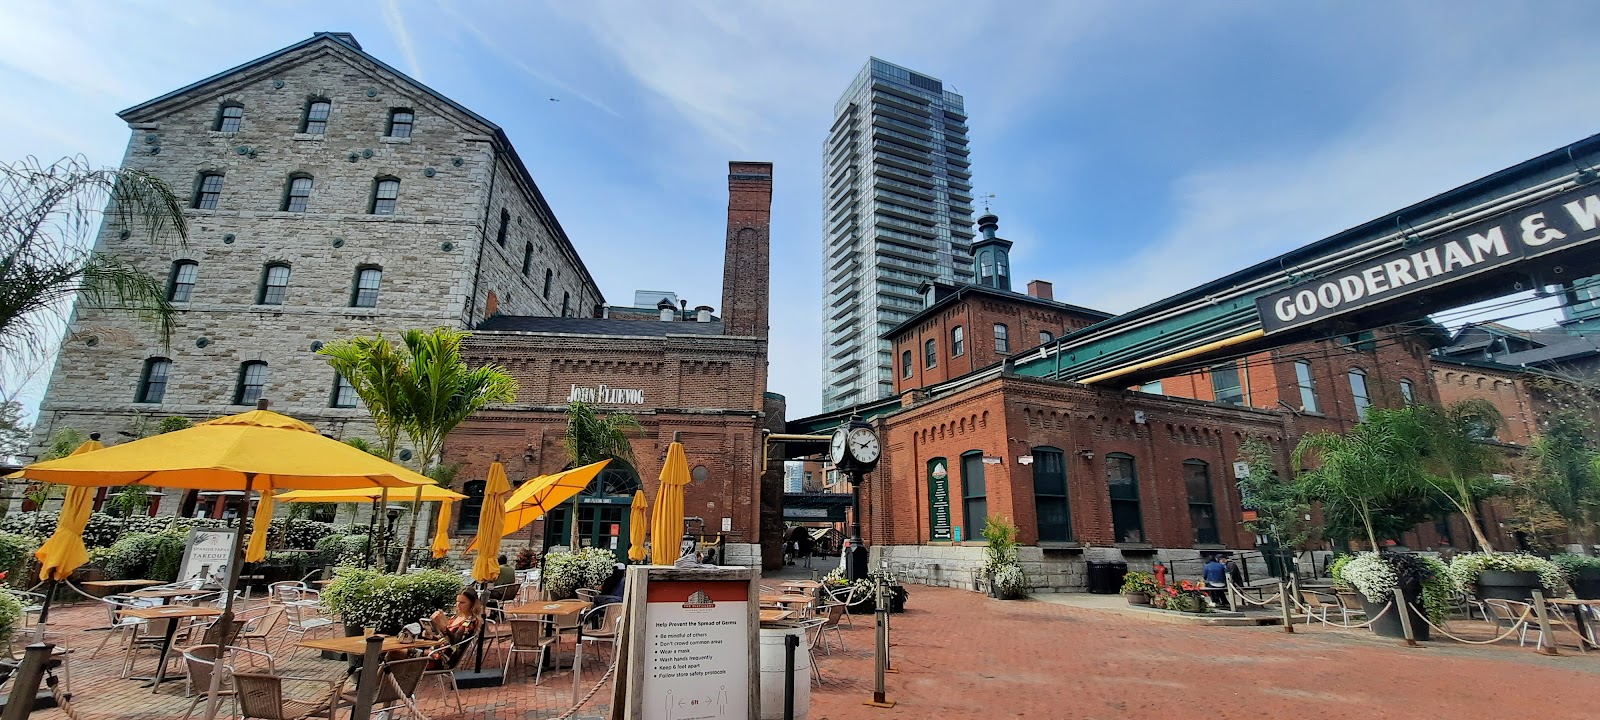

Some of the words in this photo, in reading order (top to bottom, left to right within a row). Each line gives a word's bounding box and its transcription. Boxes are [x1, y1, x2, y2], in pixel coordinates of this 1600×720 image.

[1274, 226, 1510, 322] GOODERHAM
[1519, 211, 1567, 248] &
[567, 384, 596, 403] JOHN
[598, 384, 644, 404] FLUEVOG
